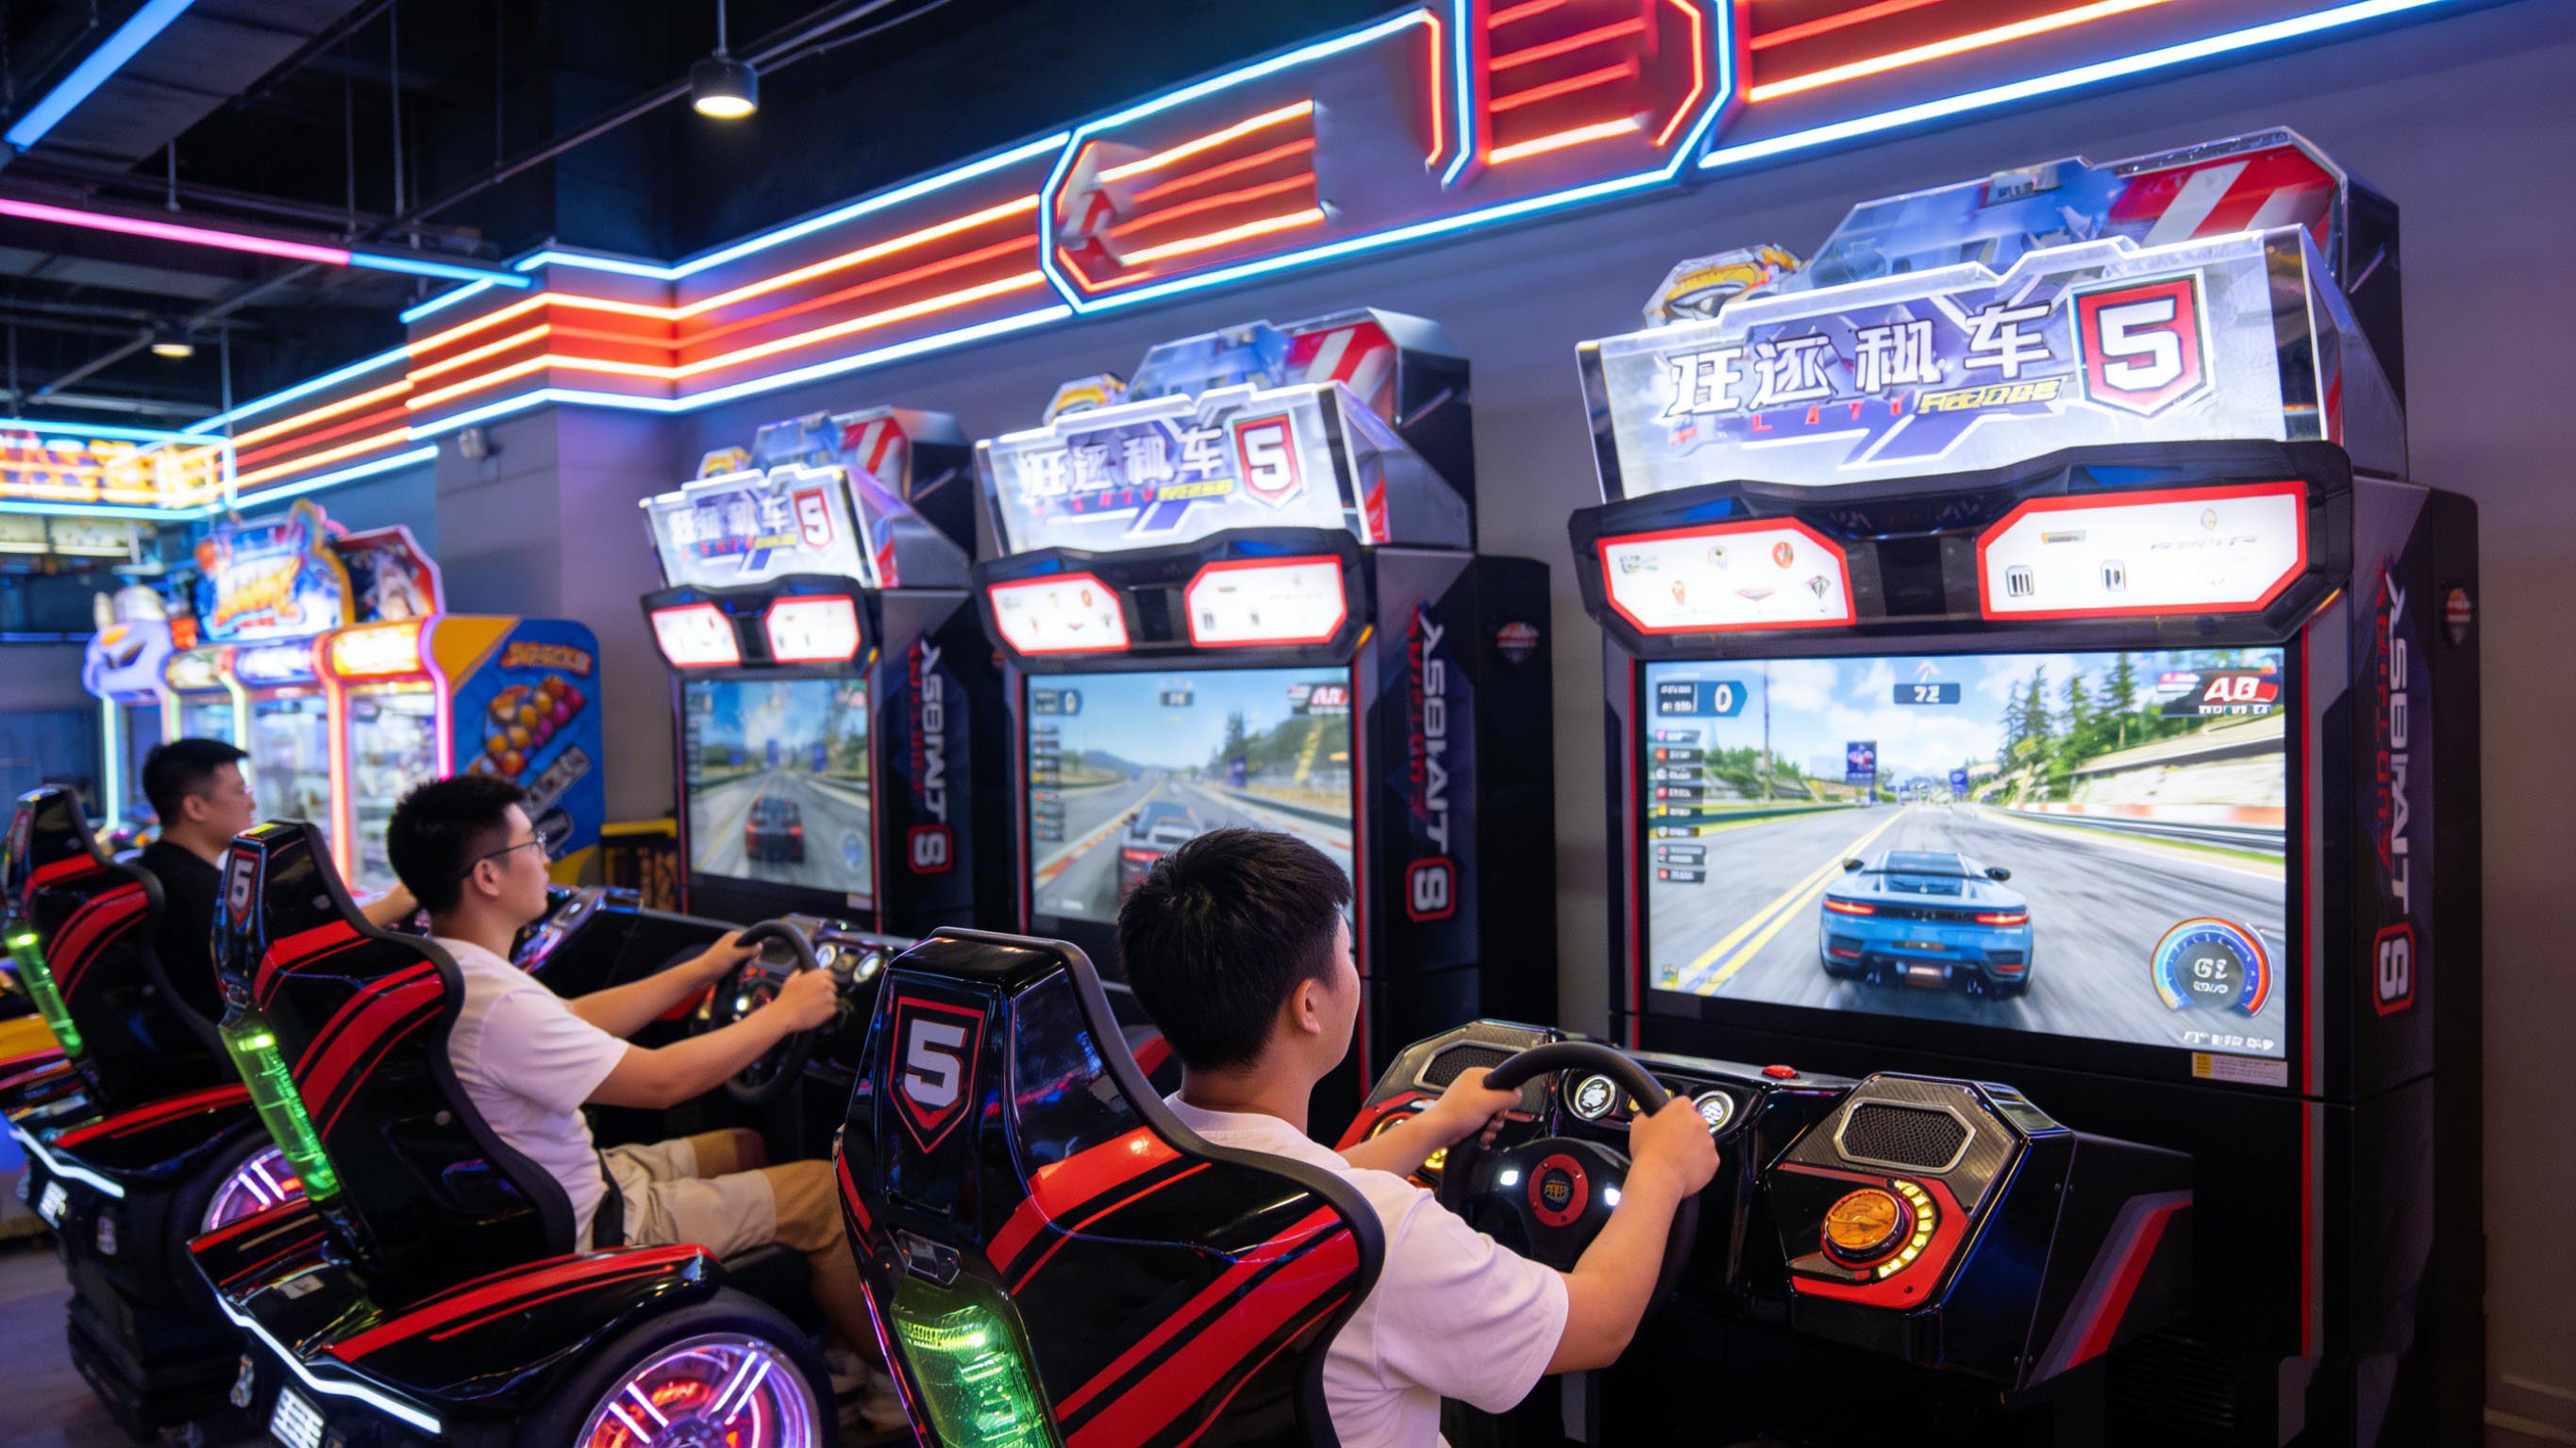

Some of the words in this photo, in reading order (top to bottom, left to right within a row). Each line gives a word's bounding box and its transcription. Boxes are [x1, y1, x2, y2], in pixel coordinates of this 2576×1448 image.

[2099, 299, 2183, 392] 5
[1244, 426, 1292, 491] 5
[904, 1018, 967, 1107] 5
